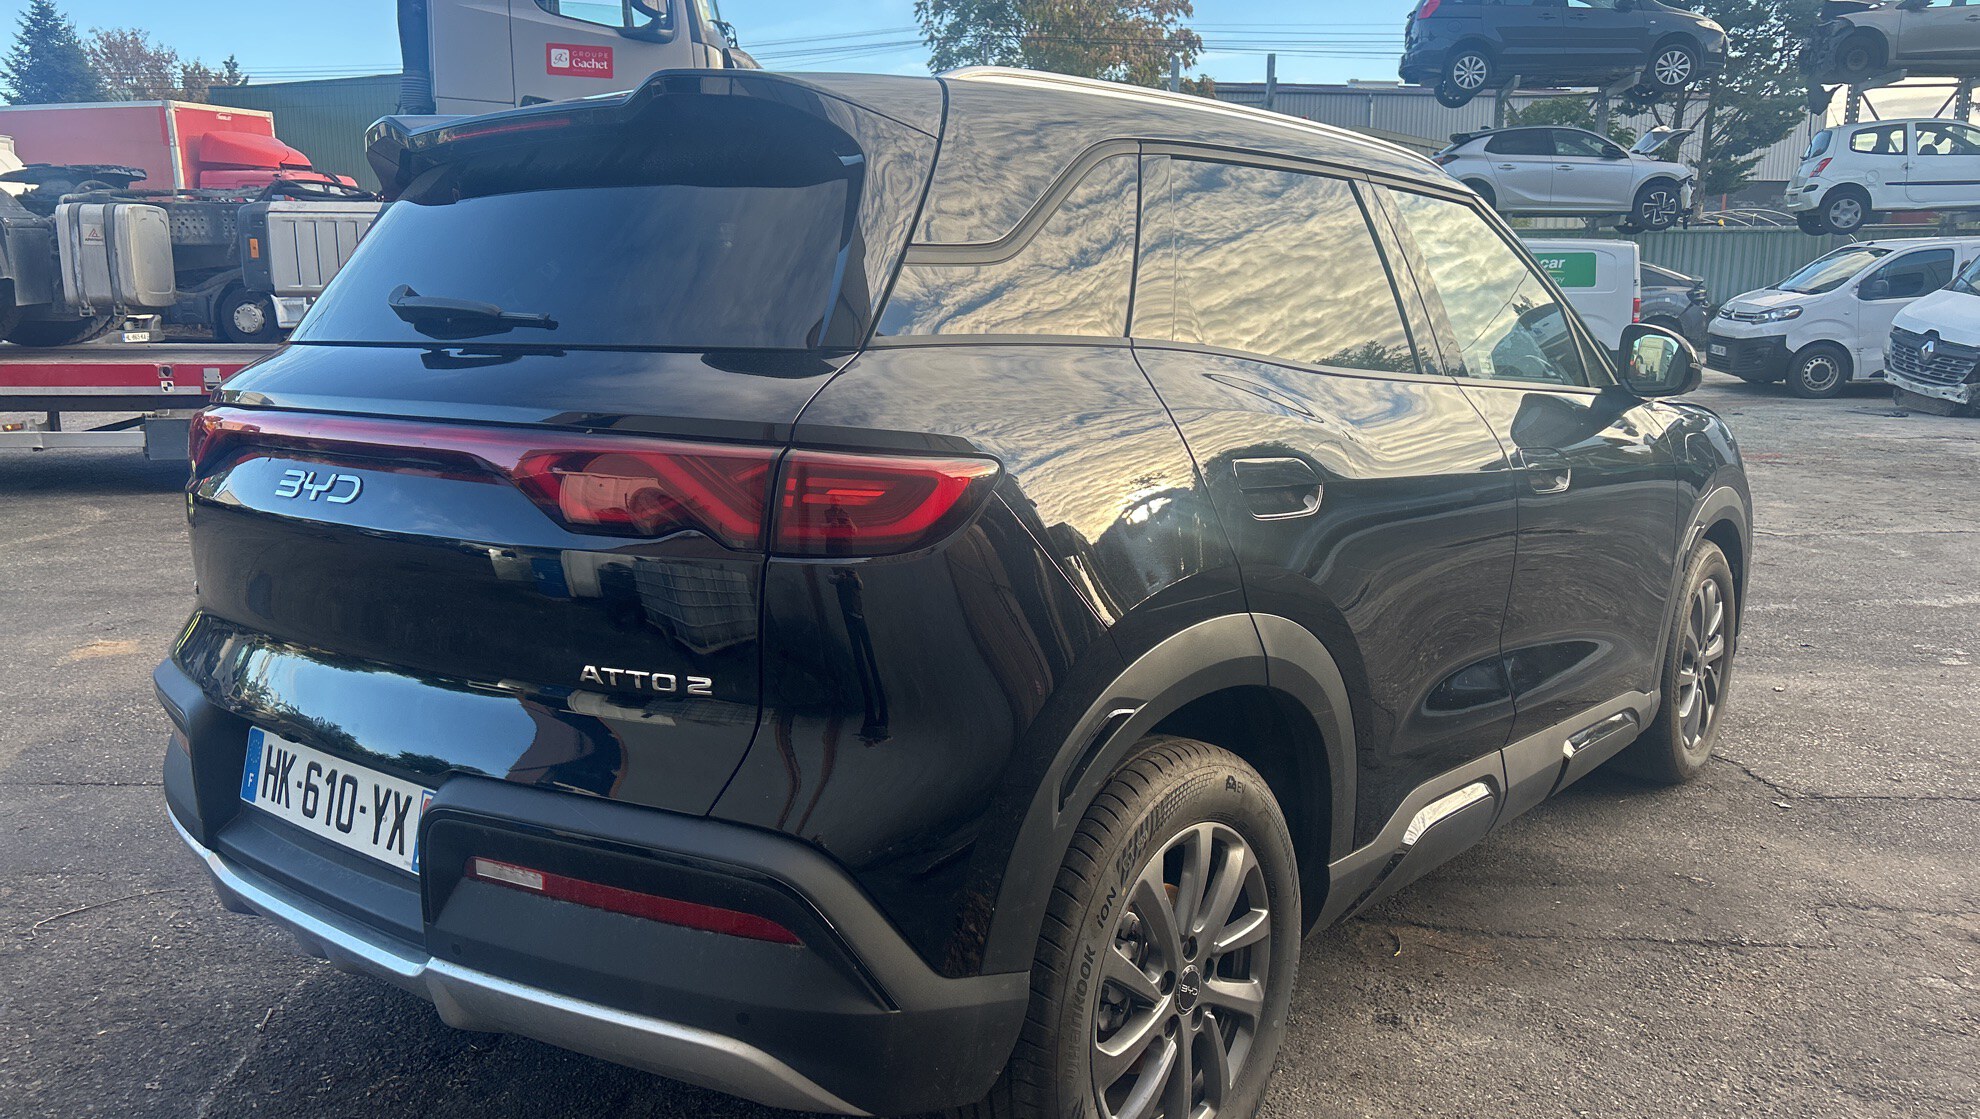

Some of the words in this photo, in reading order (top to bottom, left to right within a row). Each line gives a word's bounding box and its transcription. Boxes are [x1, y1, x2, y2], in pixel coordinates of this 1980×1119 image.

[572, 50, 609, 59] GROUPE
[572, 58, 608, 70] Gachet
[275, 469, 362, 504] BYD
[579, 664, 677, 693] ATTO
[687, 675, 713, 696] 2
[247, 773, 255, 787] F
[261, 744, 412, 856] HK-610-YX
[1181, 984, 1198, 996] BYD
